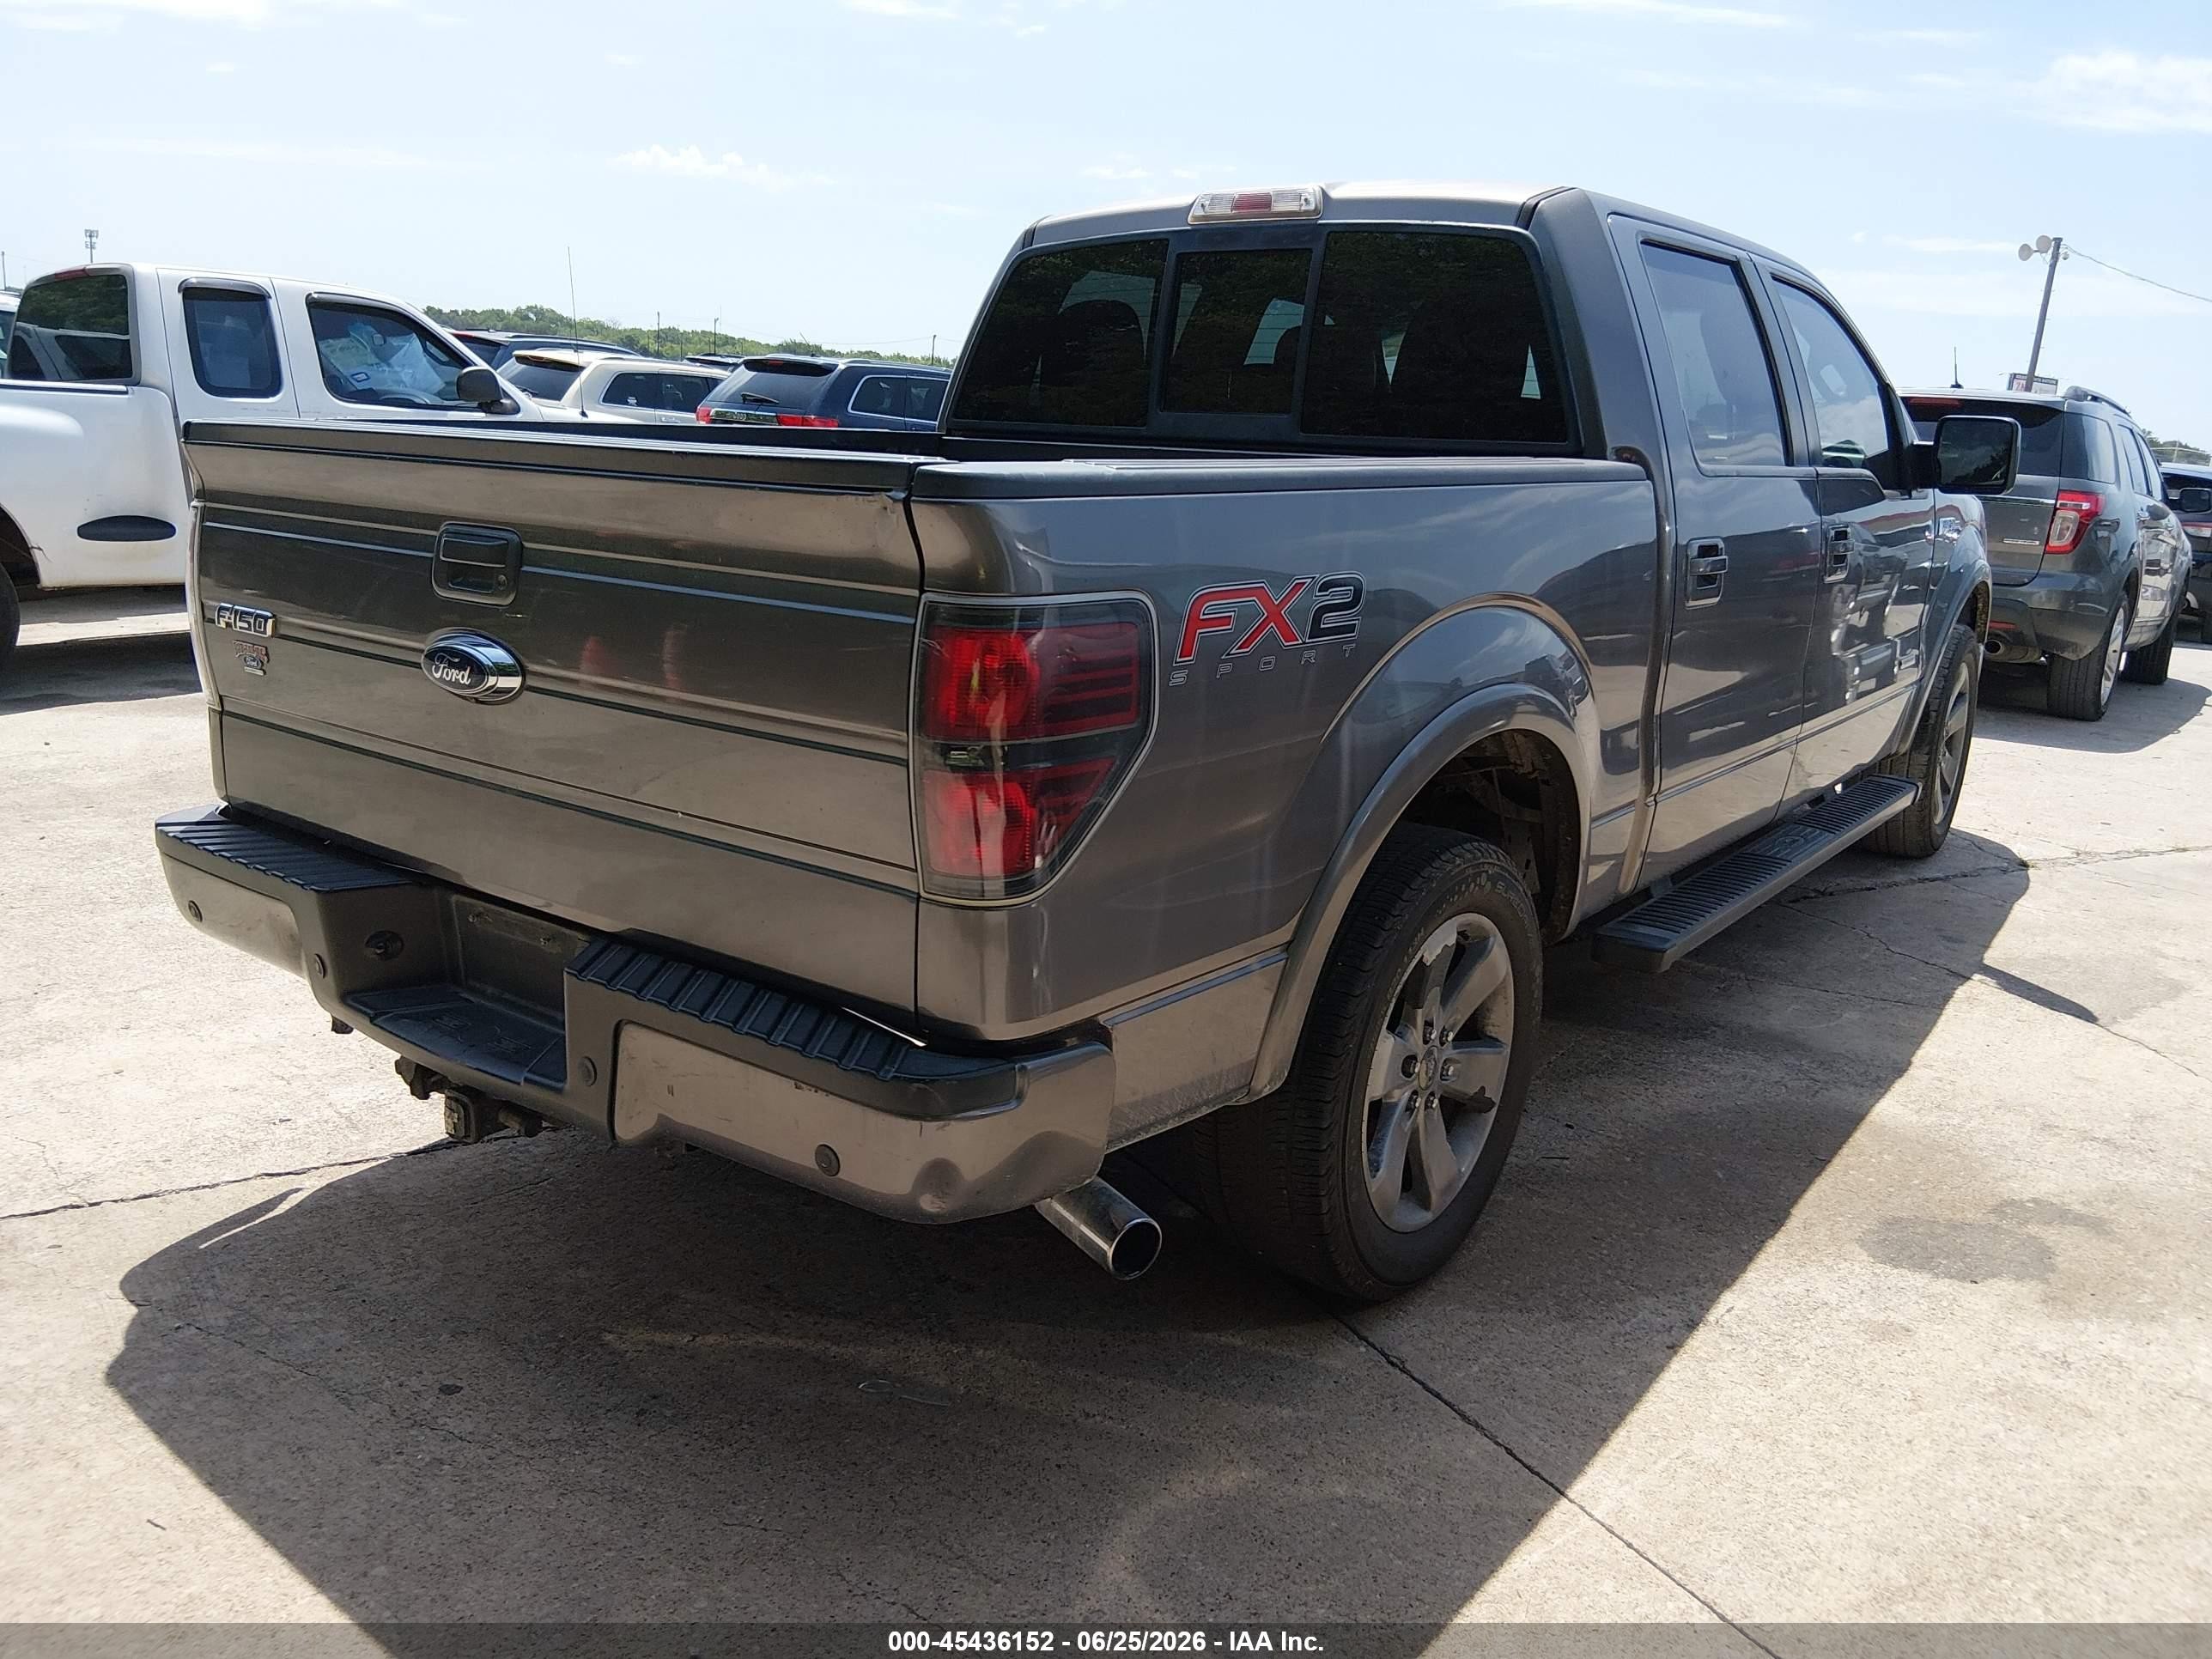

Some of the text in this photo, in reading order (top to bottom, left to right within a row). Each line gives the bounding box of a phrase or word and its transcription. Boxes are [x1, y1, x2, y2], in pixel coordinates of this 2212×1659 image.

[215, 603, 274, 637] F-150
[1172, 570, 1367, 666] FX2
[432, 653, 471, 685] Ford
[1169, 643, 1356, 687] SPORT
